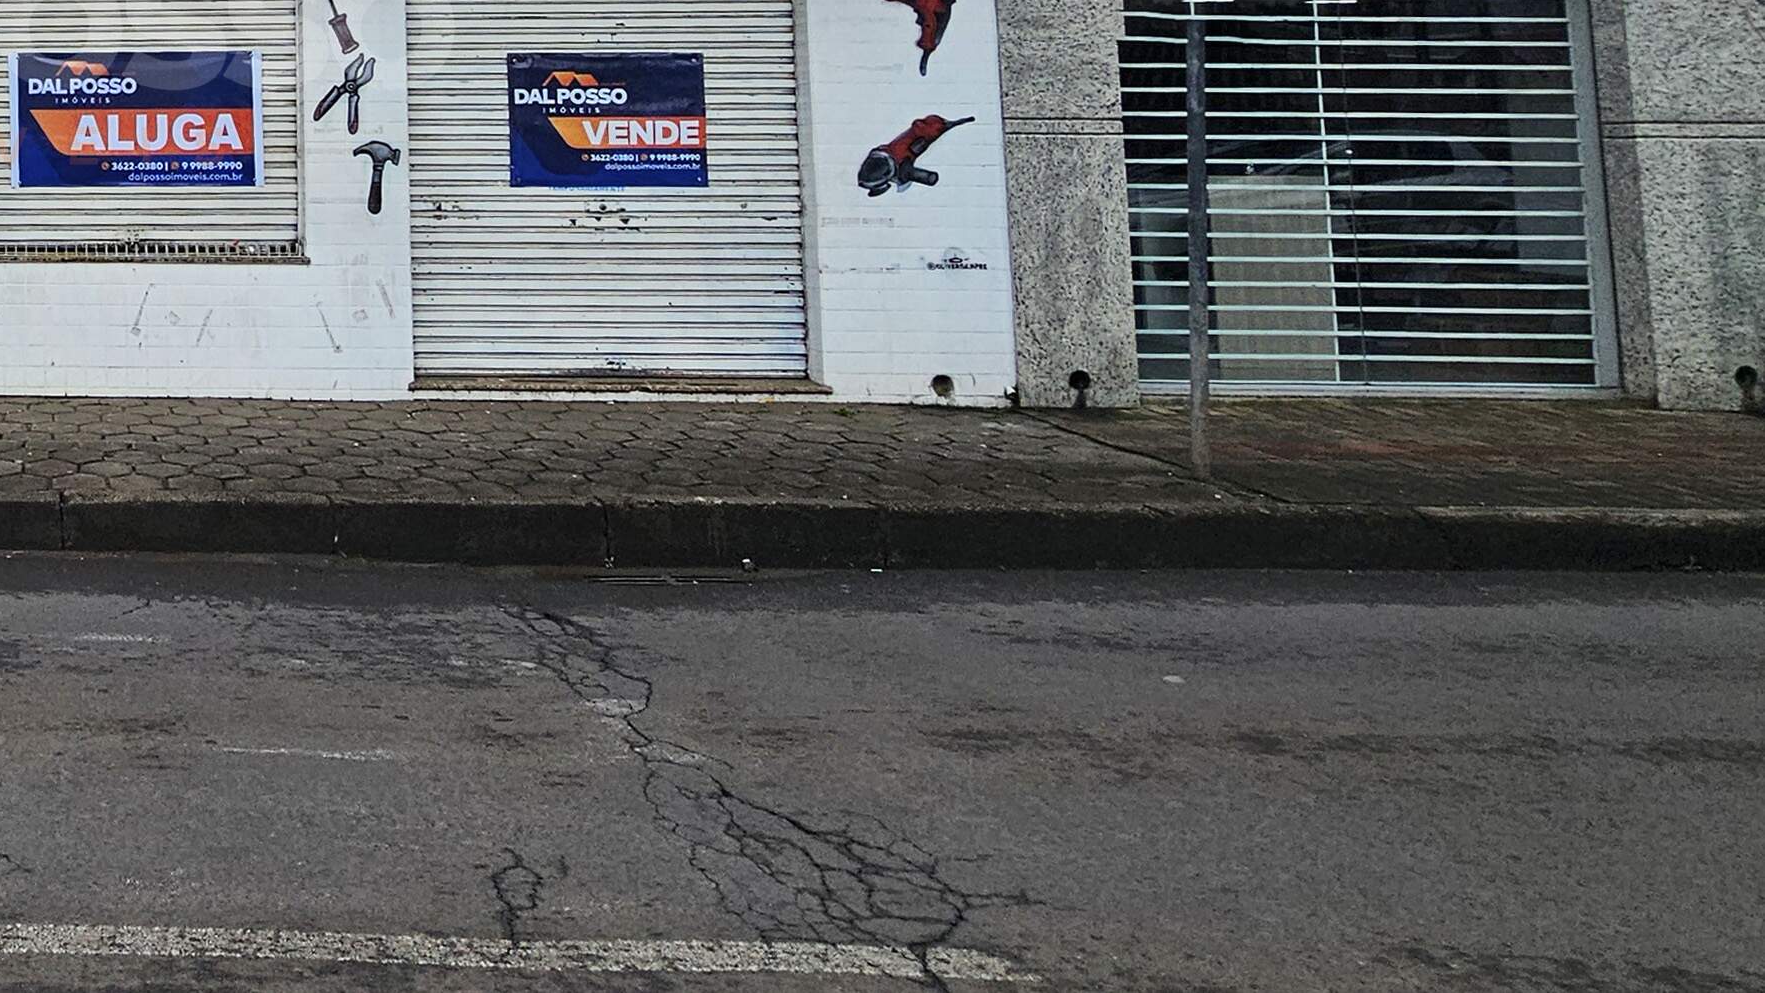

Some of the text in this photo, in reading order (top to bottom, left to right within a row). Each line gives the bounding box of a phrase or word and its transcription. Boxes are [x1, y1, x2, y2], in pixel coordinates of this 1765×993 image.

[55, 95, 111, 104] IMÓVEIS
[542, 106, 601, 114] IMÓVEIS
[70, 113, 244, 152] ALUGA
[581, 120, 700, 145] VENDE
[111, 161, 163, 171] 3622-0380
[128, 172, 243, 182] dalpossoimoveis.com.br
